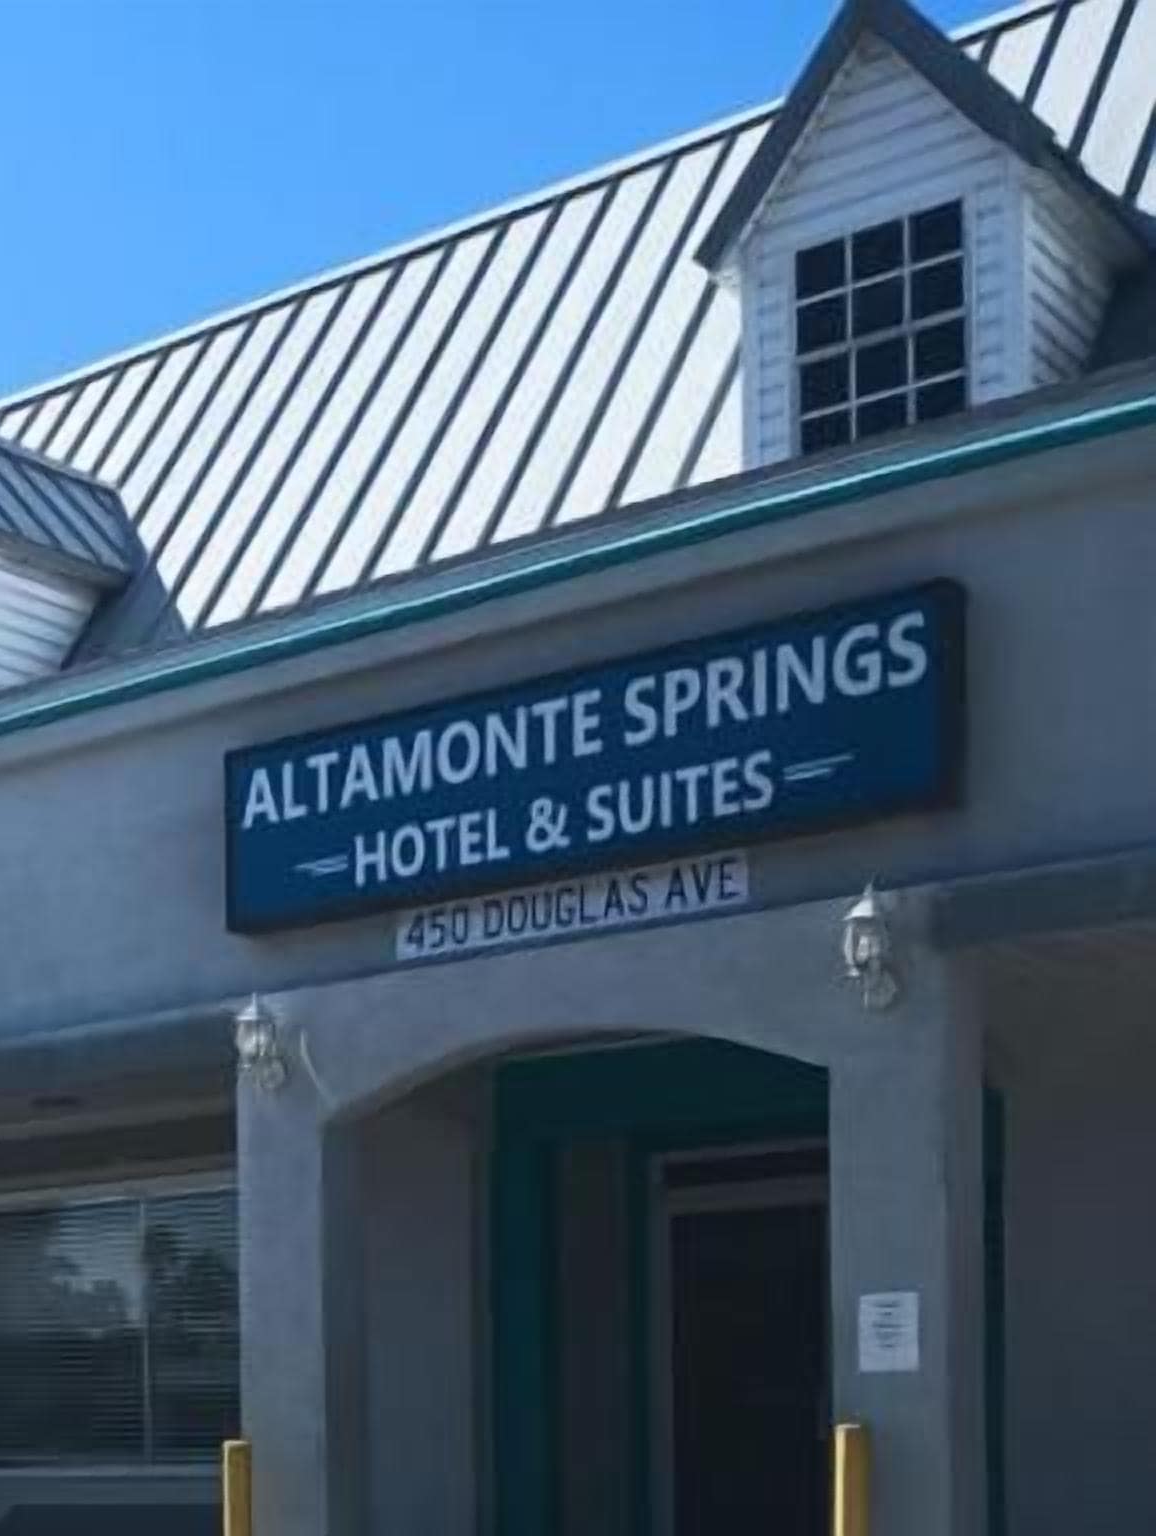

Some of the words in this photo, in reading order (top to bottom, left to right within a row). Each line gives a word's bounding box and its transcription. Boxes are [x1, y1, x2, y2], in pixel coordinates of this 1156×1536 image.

[243, 688, 604, 829] ALTAMONTE
[624, 610, 928, 747] SPRINGS
[354, 807, 509, 887] HOTEL
[525, 798, 570, 851] &
[587, 749, 774, 843] SUITES
[405, 905, 470, 951] 450
[482, 874, 649, 940] DOUGLAS
[664, 859, 740, 908] AVE
